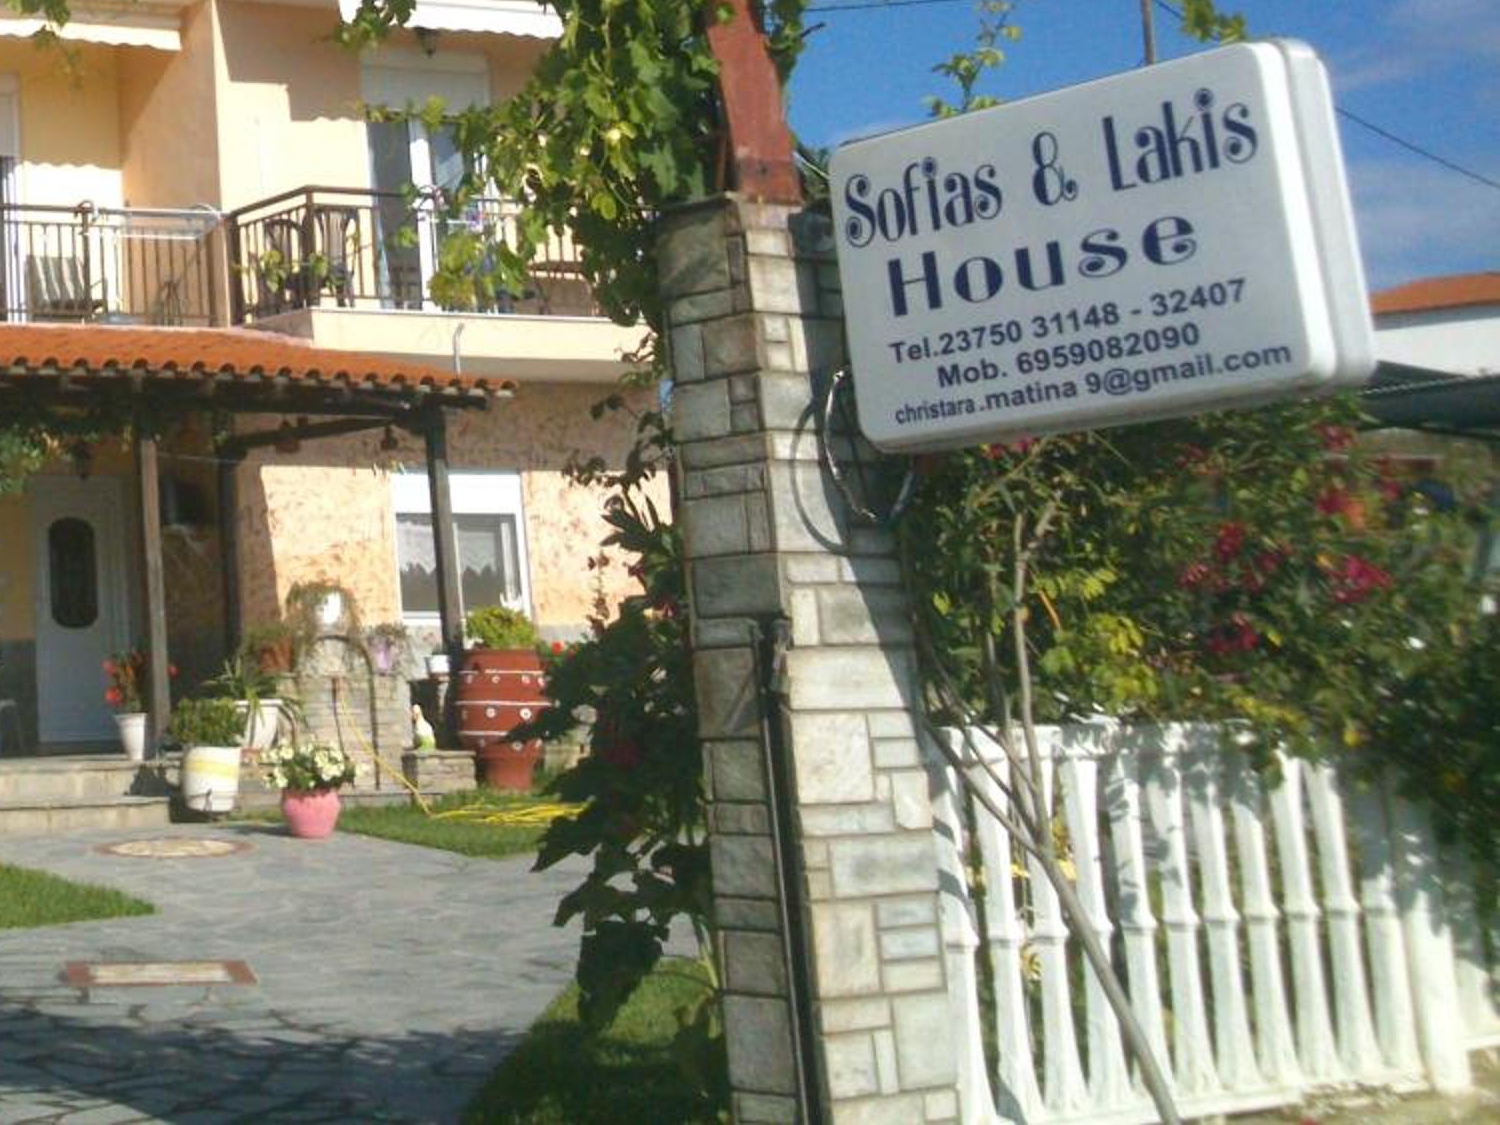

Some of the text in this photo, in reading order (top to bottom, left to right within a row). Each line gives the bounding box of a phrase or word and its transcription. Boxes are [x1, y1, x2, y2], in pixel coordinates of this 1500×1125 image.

[845, 88, 1258, 248] Sofias & Lakis
[887, 216, 1197, 317] House
[1032, 302, 1120, 338] 31148
[1150, 278, 1246, 317] 32407
[937, 322, 1200, 388] Mob. 6959082090
